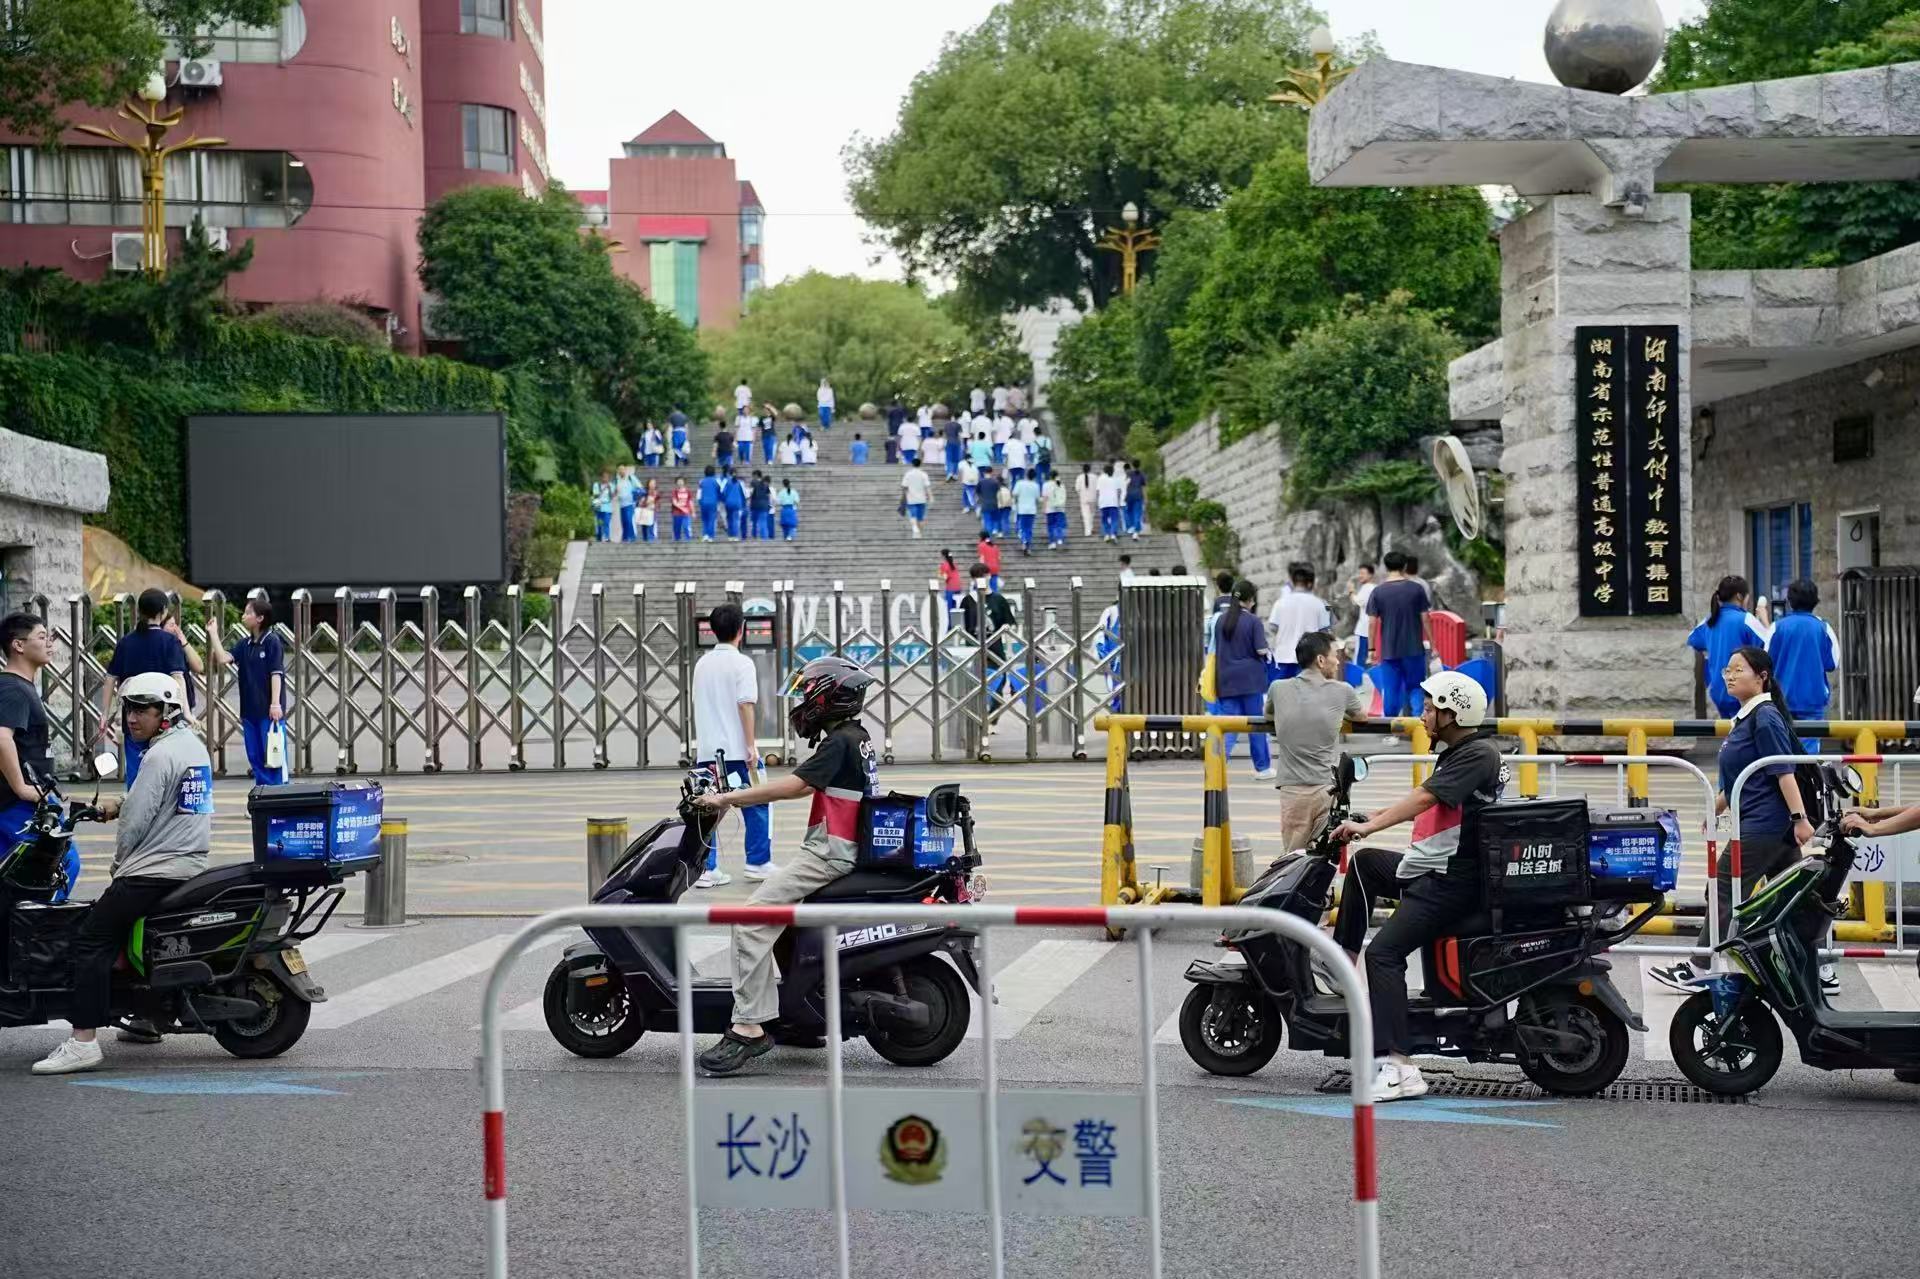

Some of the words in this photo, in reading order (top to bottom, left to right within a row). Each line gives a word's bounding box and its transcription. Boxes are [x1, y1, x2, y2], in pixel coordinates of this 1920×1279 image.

[1589, 338, 1616, 603] 湖南省示范性普通高级中学
[1643, 336, 1669, 603] 湖南师大附中教育集团
[783, 592, 1023, 643] WELCO
[282, 830, 324, 839] 考生应急护航
[296, 822, 324, 831] 招手即停
[1621, 837, 1656, 847] 招手即停
[1604, 846, 1656, 856] 考生应急护航
[1505, 859, 1563, 876] 急送全城
[717, 1112, 811, 1181] 长沙
[1022, 1117, 1119, 1187] 交警
